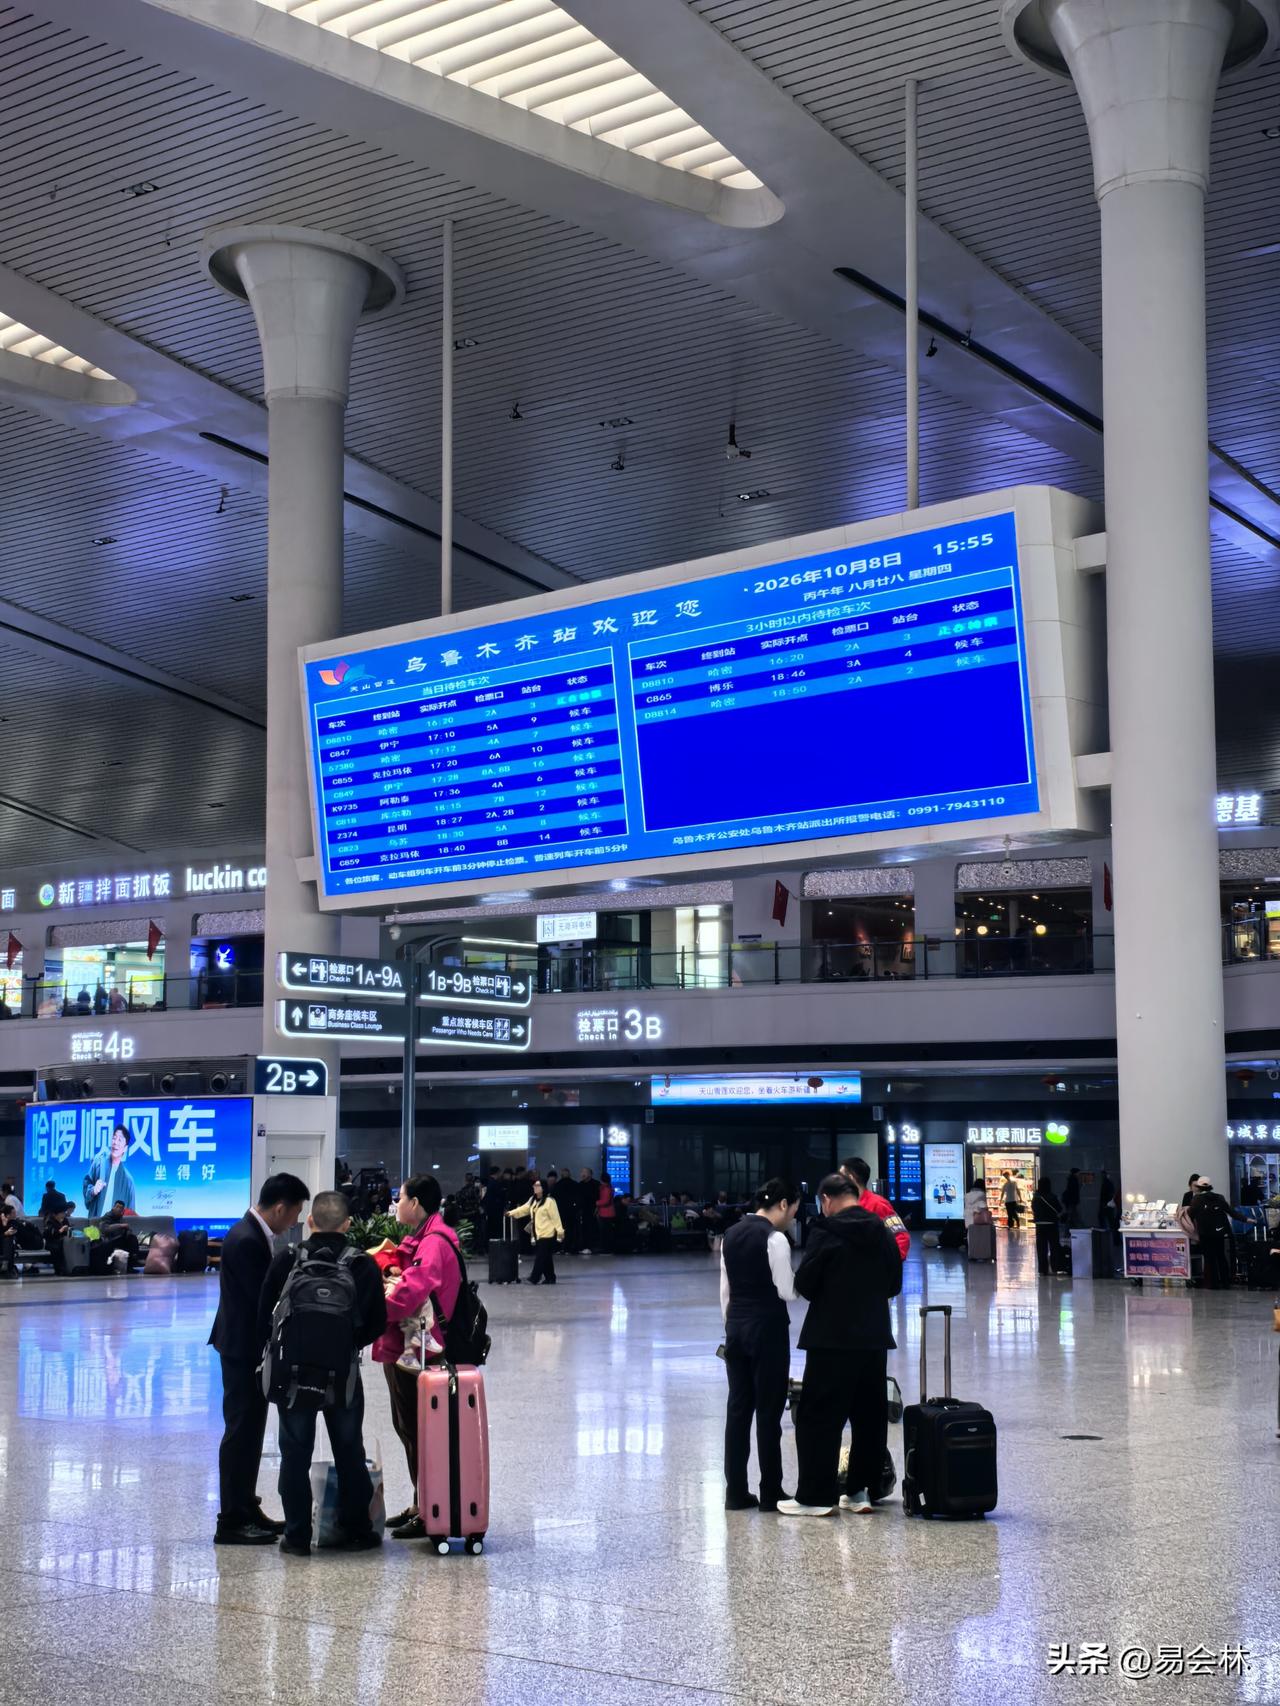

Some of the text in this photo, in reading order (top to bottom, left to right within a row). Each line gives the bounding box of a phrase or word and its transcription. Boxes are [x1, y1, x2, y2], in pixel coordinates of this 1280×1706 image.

[932, 533, 994, 556] 15:55
[754, 552, 902, 594] 2026年10月8日
[803, 562, 952, 602] 丙午年 八月廿八 星期四
[745, 601, 872, 633] 3小时以内待检车次
[405, 599, 702, 674] 乌鲁木齐站欢迎您
[645, 600, 980, 671] 车次 终到站 实际开点 检票口 站台 状态
[642, 677, 674, 689] D8810
[707, 665, 733, 677] 哈密
[769, 653, 804, 665] 16:20
[844, 642, 860, 651] 2A
[903, 633, 911, 641] 3
[646, 692, 672, 704] C865
[709, 681, 734, 693] 博乐
[771, 669, 806, 682] 18:46
[846, 659, 861, 667] 3A
[954, 637, 984, 650] 候车
[422, 676, 490, 696] 当日待检车次
[644, 707, 677, 720] D8814
[772, 685, 807, 698] 18:50
[847, 676, 863, 685] 2A
[956, 653, 986, 667] 候车
[328, 720, 346, 729] 车次
[420, 700, 457, 713] 实际开点
[475, 691, 504, 703] 检票口
[521, 684, 542, 695] 站台
[567, 675, 588, 686] 状态
[329, 749, 350, 758] C847
[428, 731, 455, 742] 17:10
[486, 723, 499, 732] 5A
[569, 706, 592, 718] 候车
[427, 716, 454, 728] 16:20
[332, 776, 353, 785] C855
[431, 759, 458, 769] 17:20
[489, 752, 501, 760] 6A
[532, 745, 543, 753] 10
[571, 736, 595, 748] 候车
[332, 804, 358, 813] K9735
[433, 788, 461, 798] 17:36
[491, 781, 504, 789] 4A
[574, 766, 598, 778] 候车
[535, 789, 547, 797] 12
[337, 831, 358, 840] Z374
[387, 823, 407, 833] 昆明
[435, 816, 463, 826] 18:27
[539, 804, 545, 812] 2
[577, 796, 600, 807] 候车
[907, 797, 1005, 816] 0991-7943110
[339, 858, 360, 867] C859
[439, 844, 466, 854] 18:40
[496, 838, 509, 846] 8B
[539, 833, 551, 841] 14
[579, 825, 603, 837] 候车
[58, 873, 171, 905] 新疆拌面抓饭
[186, 864, 242, 892] luckin
[1, 888, 16, 910] 面
[329, 962, 402, 988] 检票口 1A-9A
[329, 975, 344, 983] Check
[428, 970, 495, 993] 1B-9B 检票口
[475, 986, 489, 994] Check
[328, 1008, 378, 1022] 商务座候车区
[328, 1021, 350, 1029] Business
[364, 1022, 383, 1031] Lounge
[442, 1016, 494, 1030] 重点旅客候车区
[578, 1018, 618, 1032] 检票口
[624, 1008, 662, 1040] 3B
[104, 1030, 134, 1059] 4B
[432, 1026, 457, 1036] Passenger
[467, 1028, 482, 1037] Needs
[482, 1029, 494, 1037] Care
[265, 1063, 297, 1092] 2B
[32, 1104, 217, 1163] 哈啰顺风车
[607, 1126, 629, 1145] 3B
[154, 1163, 216, 1181] 坐得好
